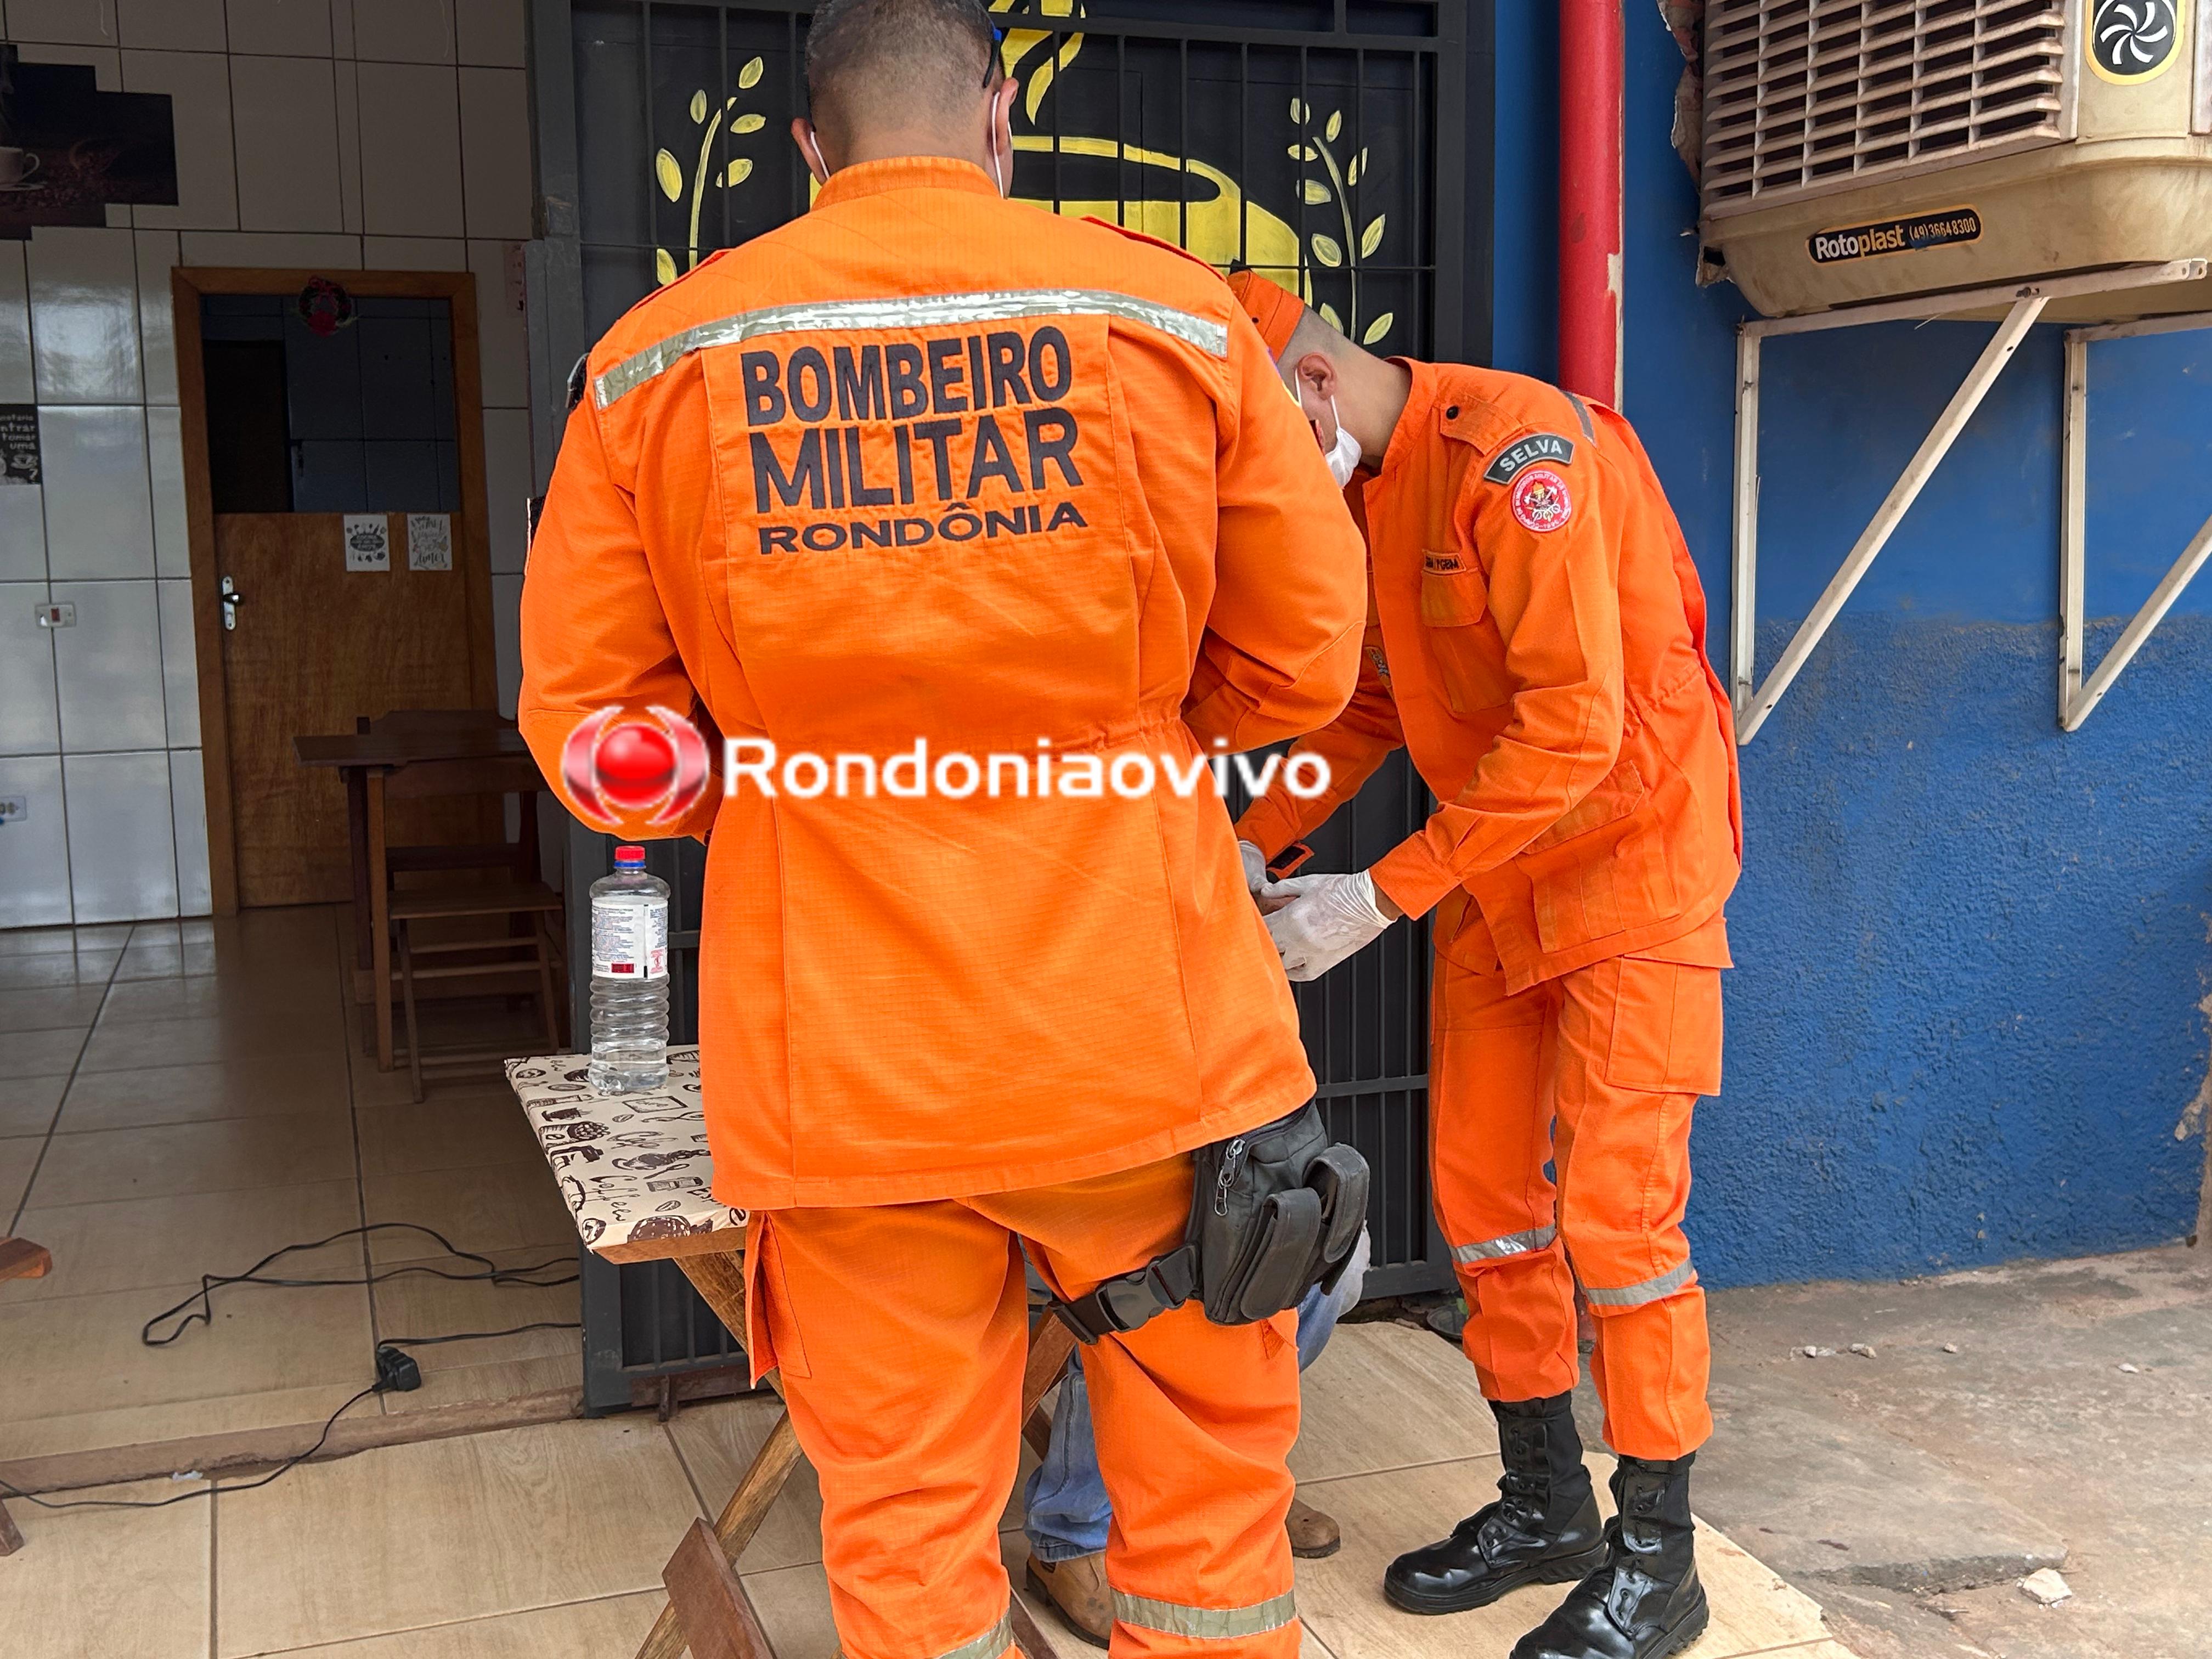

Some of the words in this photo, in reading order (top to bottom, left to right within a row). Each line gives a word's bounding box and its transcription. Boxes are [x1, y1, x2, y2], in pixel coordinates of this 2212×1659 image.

[1815, 225, 1906, 259] Rotoplast
[740, 326, 1072, 426] BOMBEIRO
[0, 421, 36, 432] ntrar
[749, 407, 1085, 514] MILITAR
[1499, 439, 1563, 472] SELVA
[758, 501, 1088, 555] RONDÔNIA
